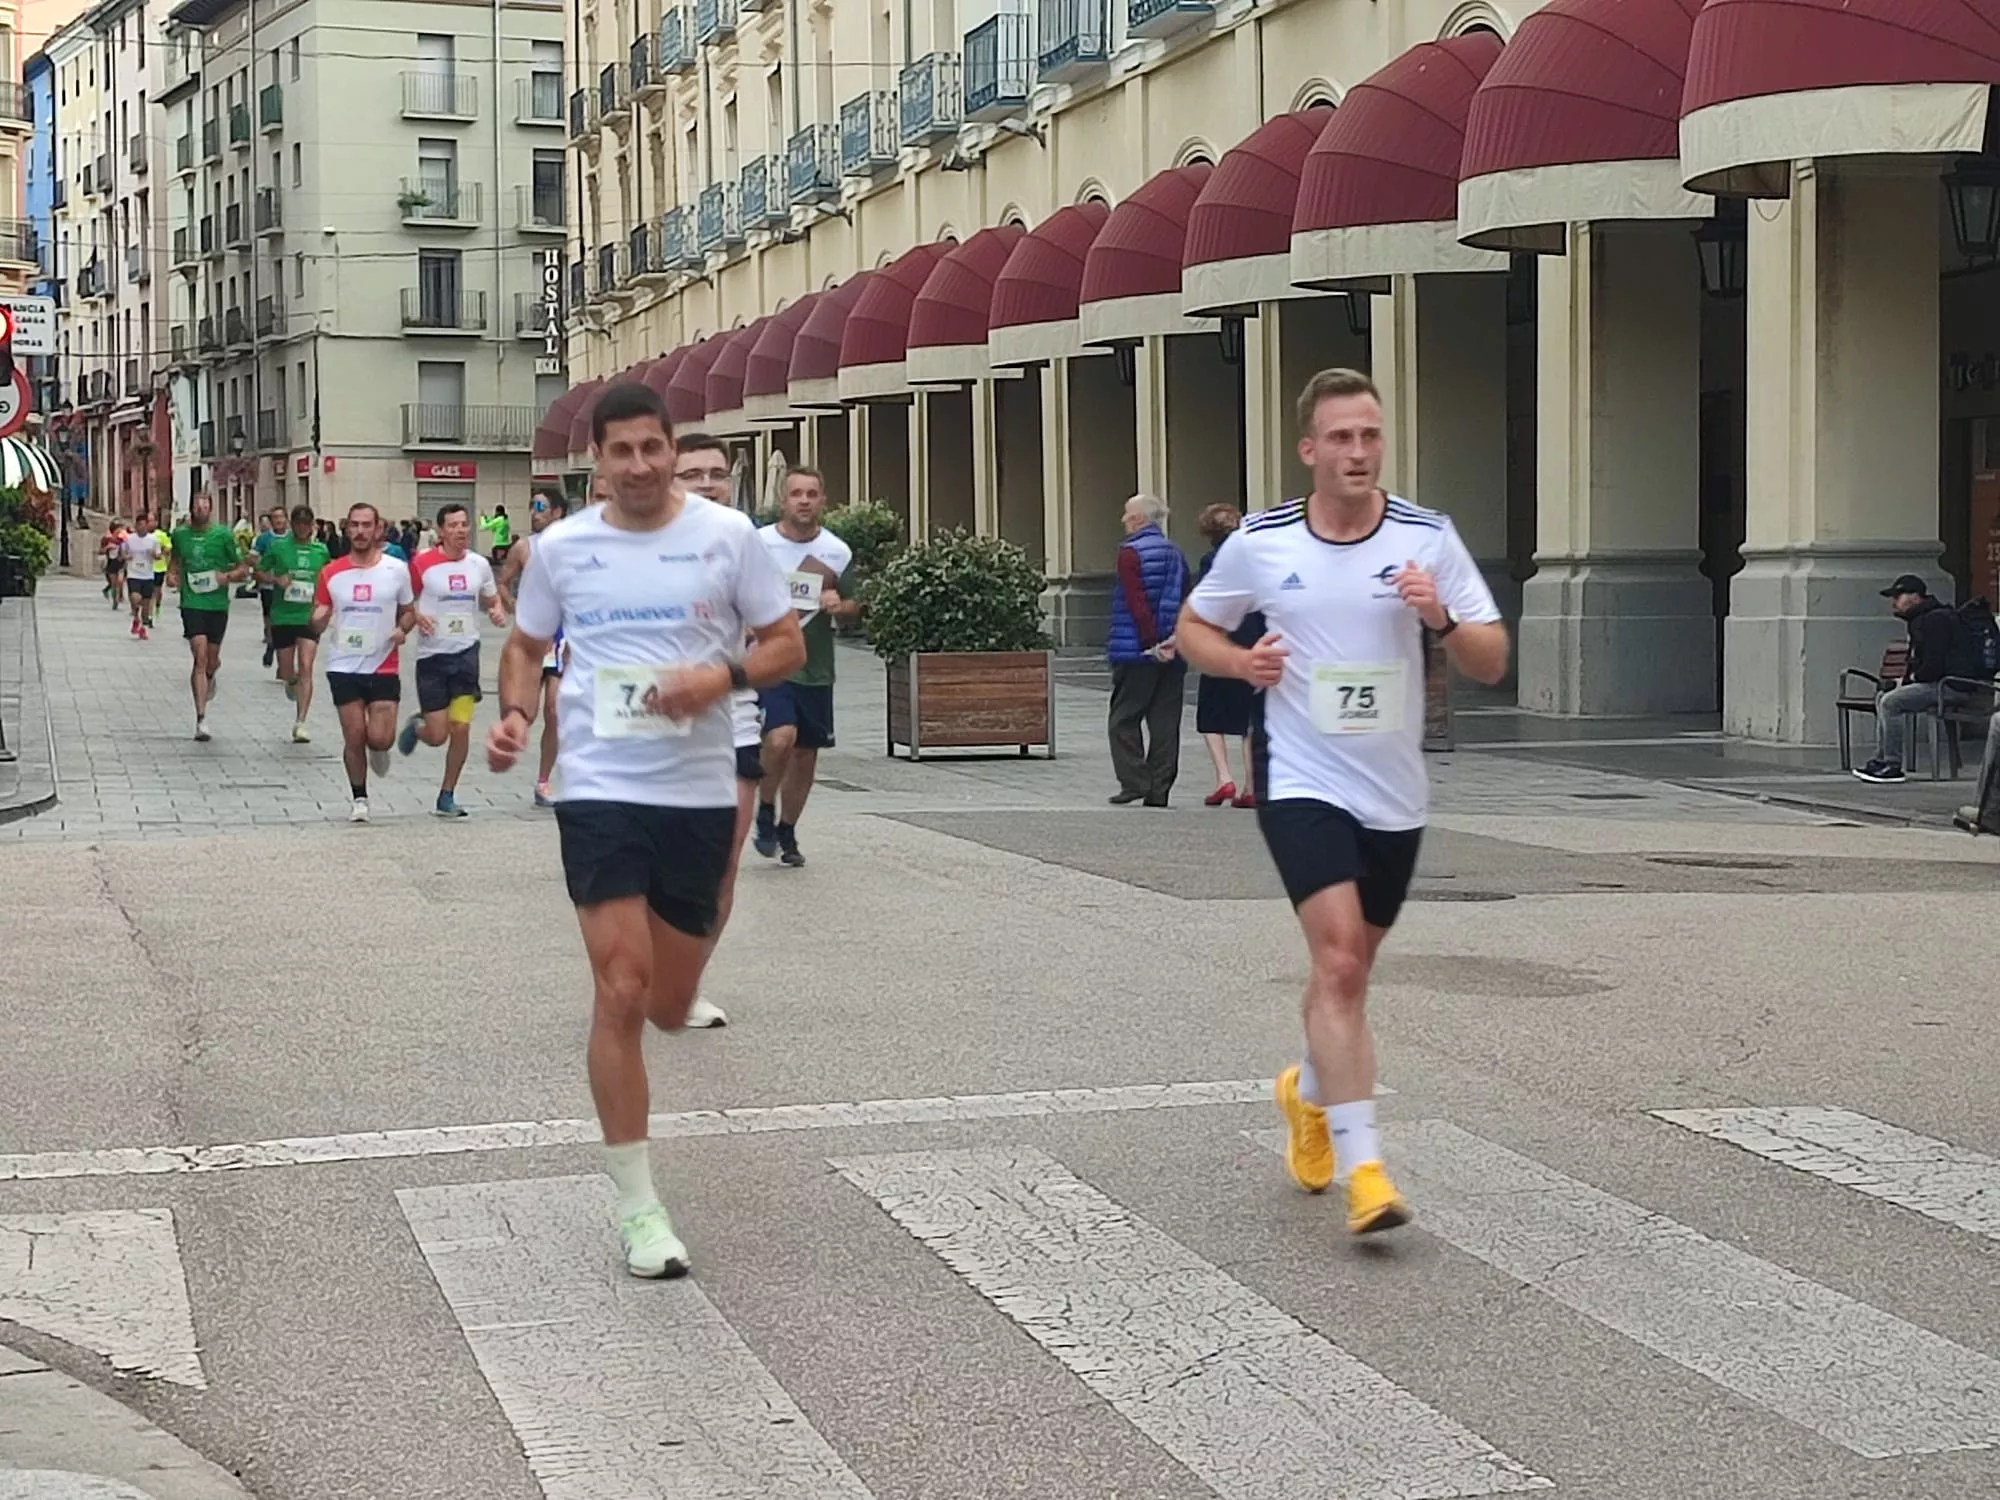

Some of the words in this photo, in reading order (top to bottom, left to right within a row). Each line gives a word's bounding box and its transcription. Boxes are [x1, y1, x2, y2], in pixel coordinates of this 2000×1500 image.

[544, 249, 559, 354] HOSTAL
[431, 465, 461, 477] GAES
[1337, 685, 1376, 708] 75
